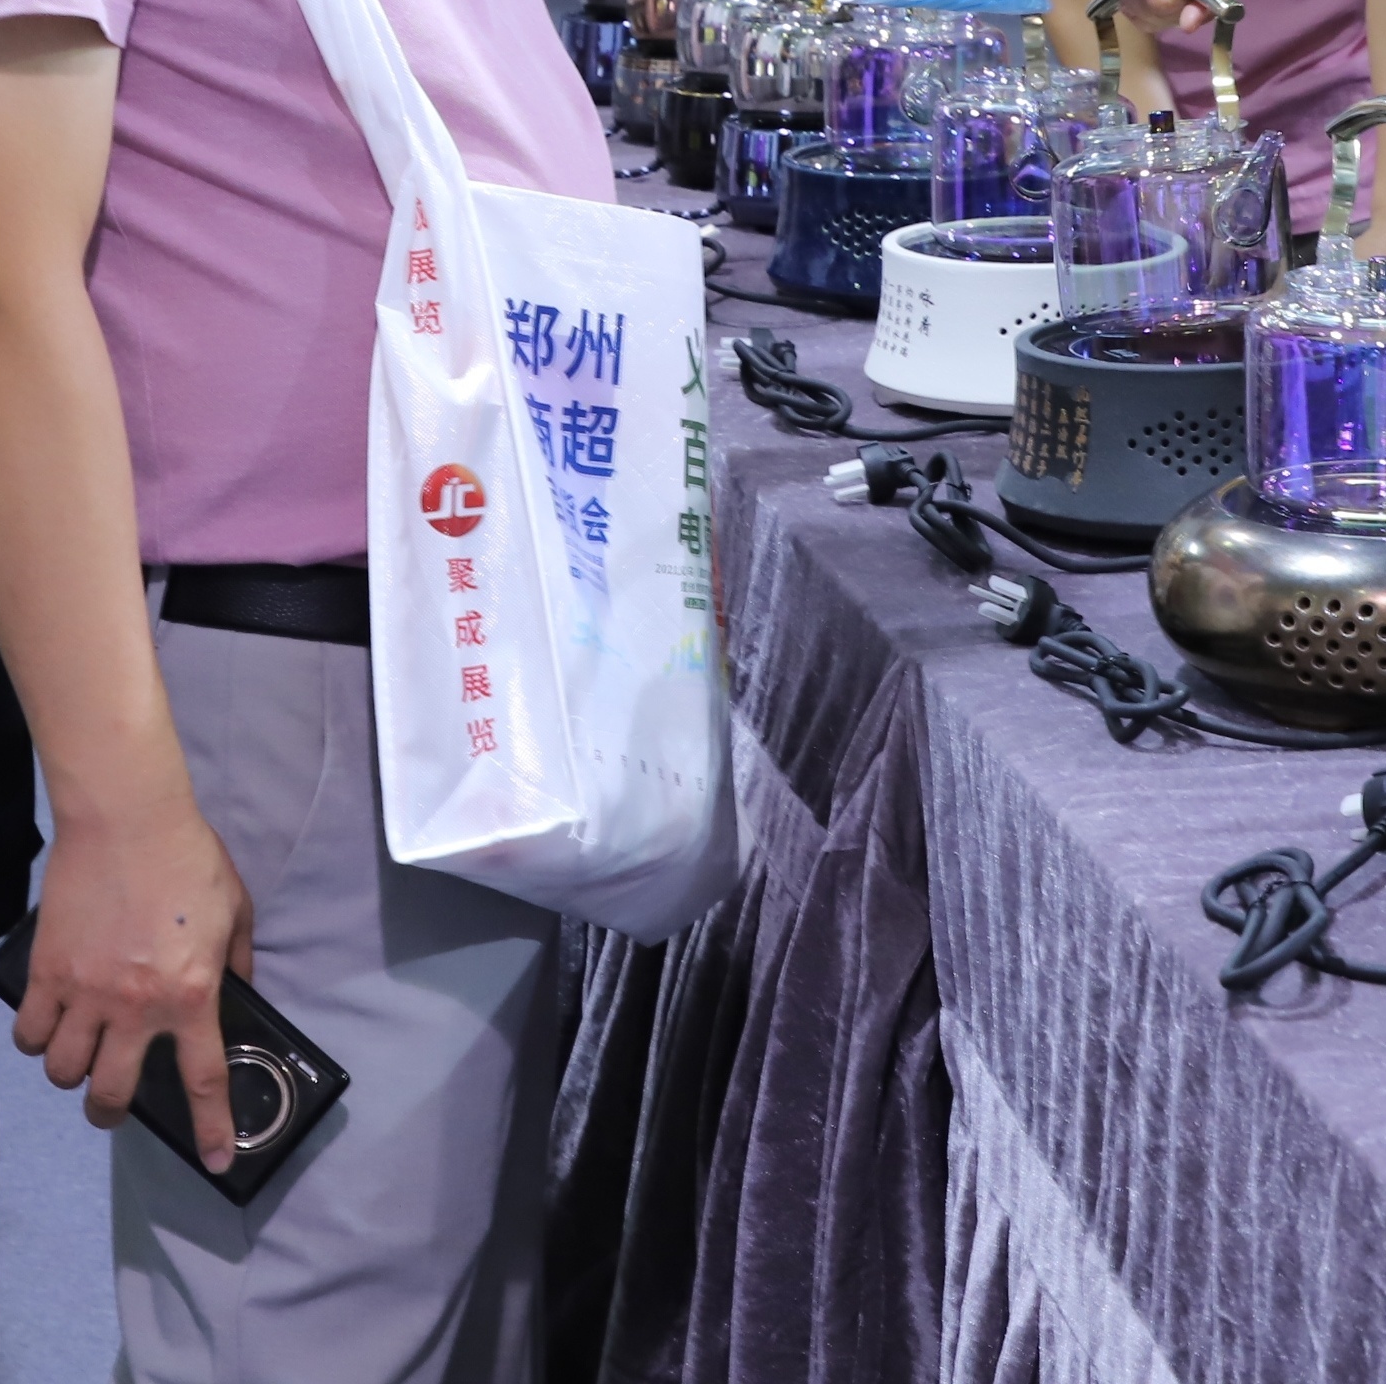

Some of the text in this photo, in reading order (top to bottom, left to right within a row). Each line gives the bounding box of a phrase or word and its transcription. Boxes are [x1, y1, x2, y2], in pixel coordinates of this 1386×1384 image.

[504, 295, 626, 387] 郑州
[445, 557, 500, 758] 聚成展览
